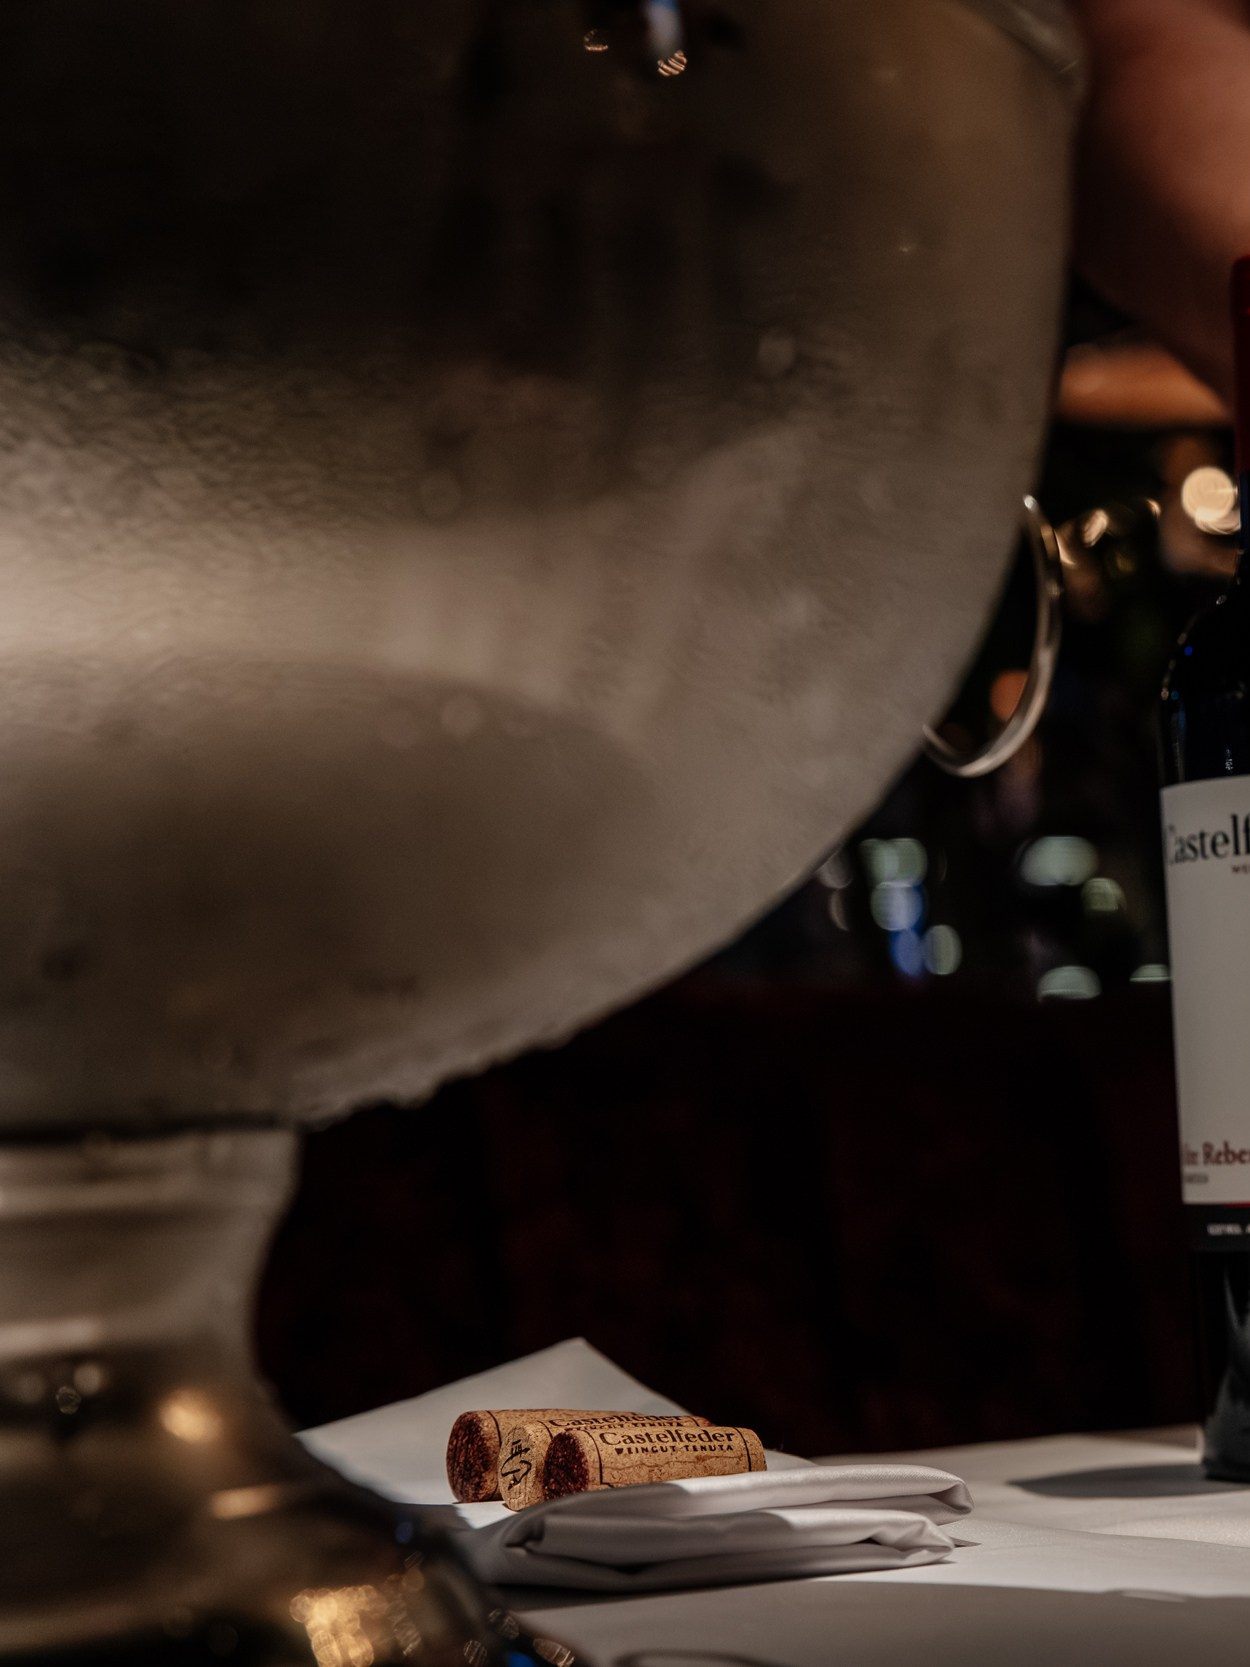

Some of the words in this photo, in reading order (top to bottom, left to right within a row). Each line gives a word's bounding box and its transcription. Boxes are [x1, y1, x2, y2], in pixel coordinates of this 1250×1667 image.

[600, 1429, 735, 1445] Castelfeder
[615, 1445, 676, 1455] WEINGUT
[684, 1444, 733, 1452] TENUTA
